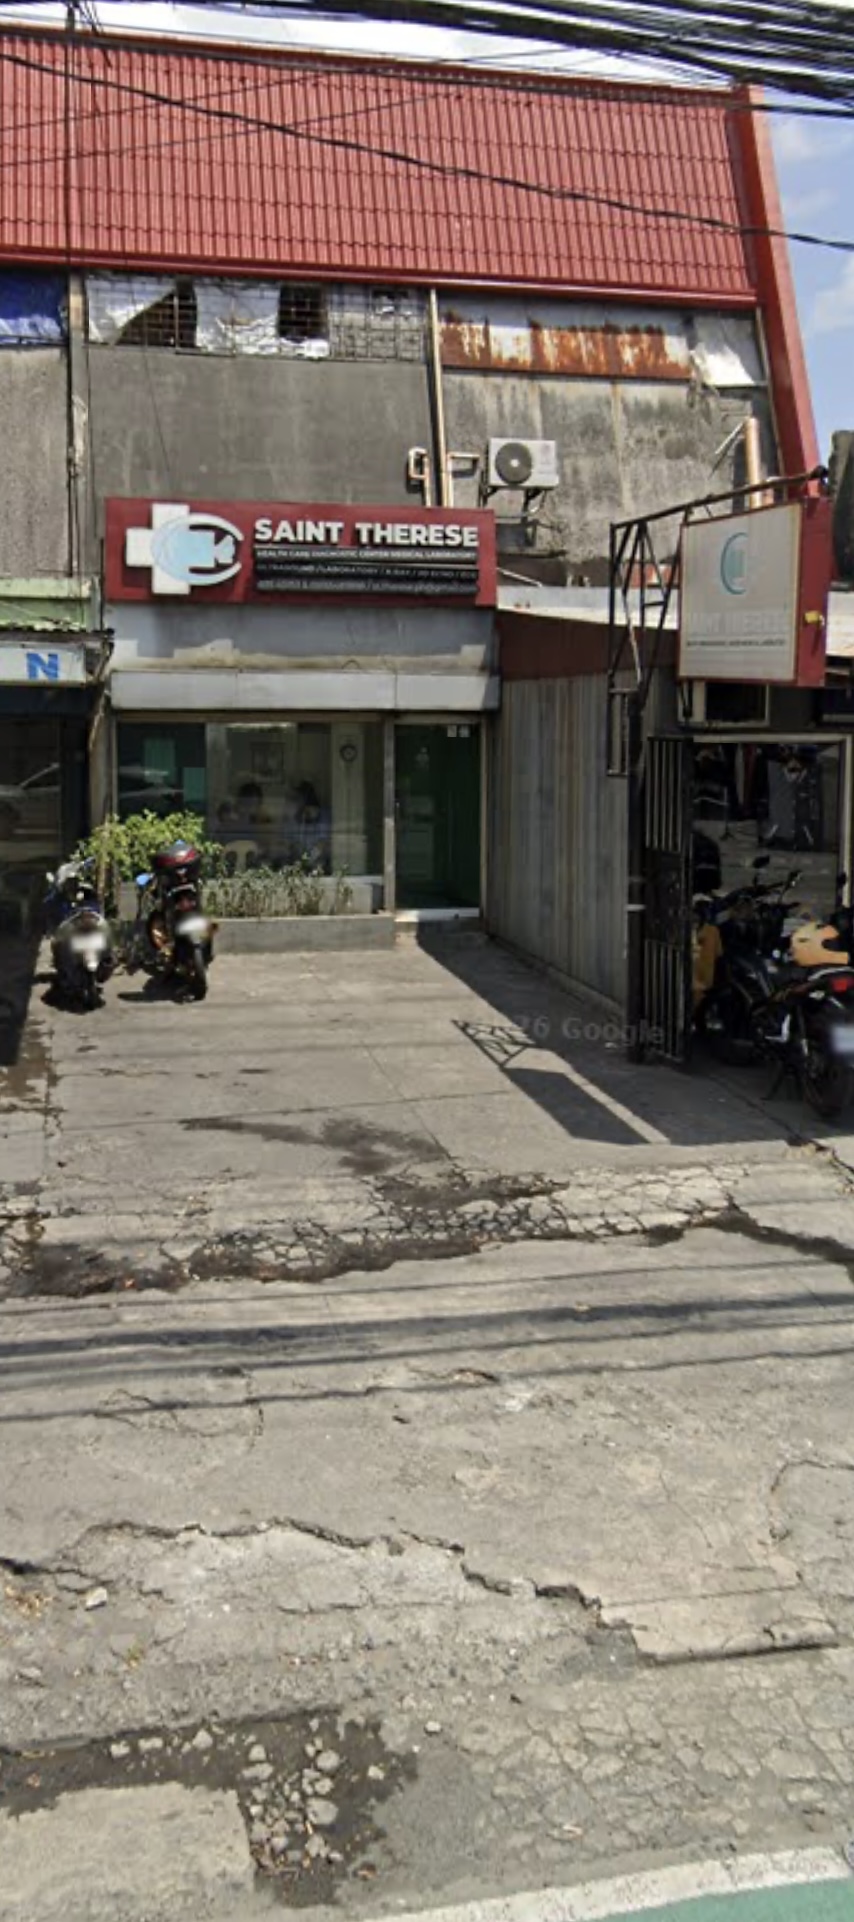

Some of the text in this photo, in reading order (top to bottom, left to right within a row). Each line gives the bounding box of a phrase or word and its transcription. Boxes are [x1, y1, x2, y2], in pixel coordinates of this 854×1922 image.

[254, 517, 479, 547] SAINT THERESE
[257, 550, 287, 558] HEALTH
[26, 652, 59, 682] N
